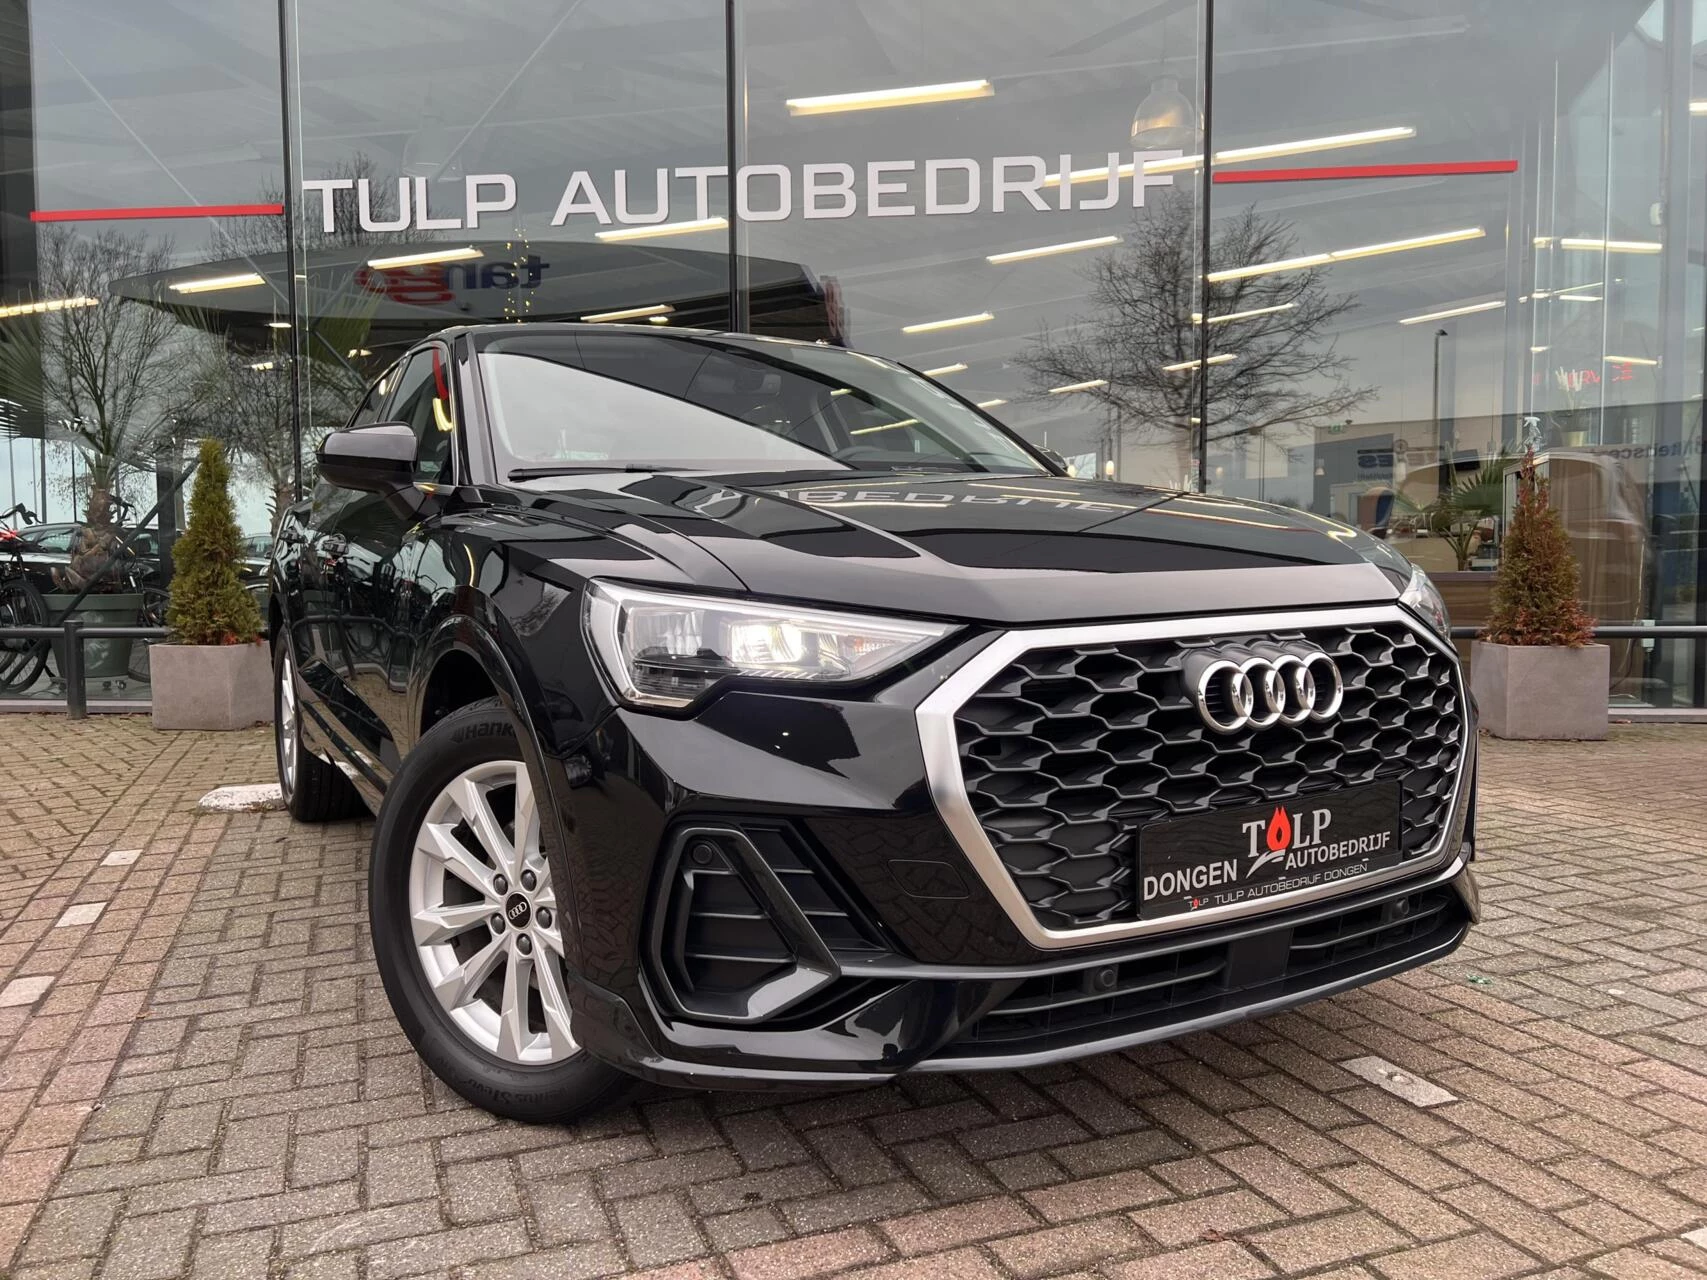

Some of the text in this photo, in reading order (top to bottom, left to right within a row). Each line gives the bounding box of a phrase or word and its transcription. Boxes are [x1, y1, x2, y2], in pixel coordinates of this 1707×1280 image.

[302, 149, 1183, 233] TULP AUTOBEDRIJF
[1285, 831, 1391, 871] AUTOBEDRIJF
[1143, 859, 1239, 901] DONGEN
[1214, 890, 1245, 905] TULP
[1247, 873, 1322, 898] AUTOBEDRIJF
[1323, 863, 1369, 882] DONGEN
